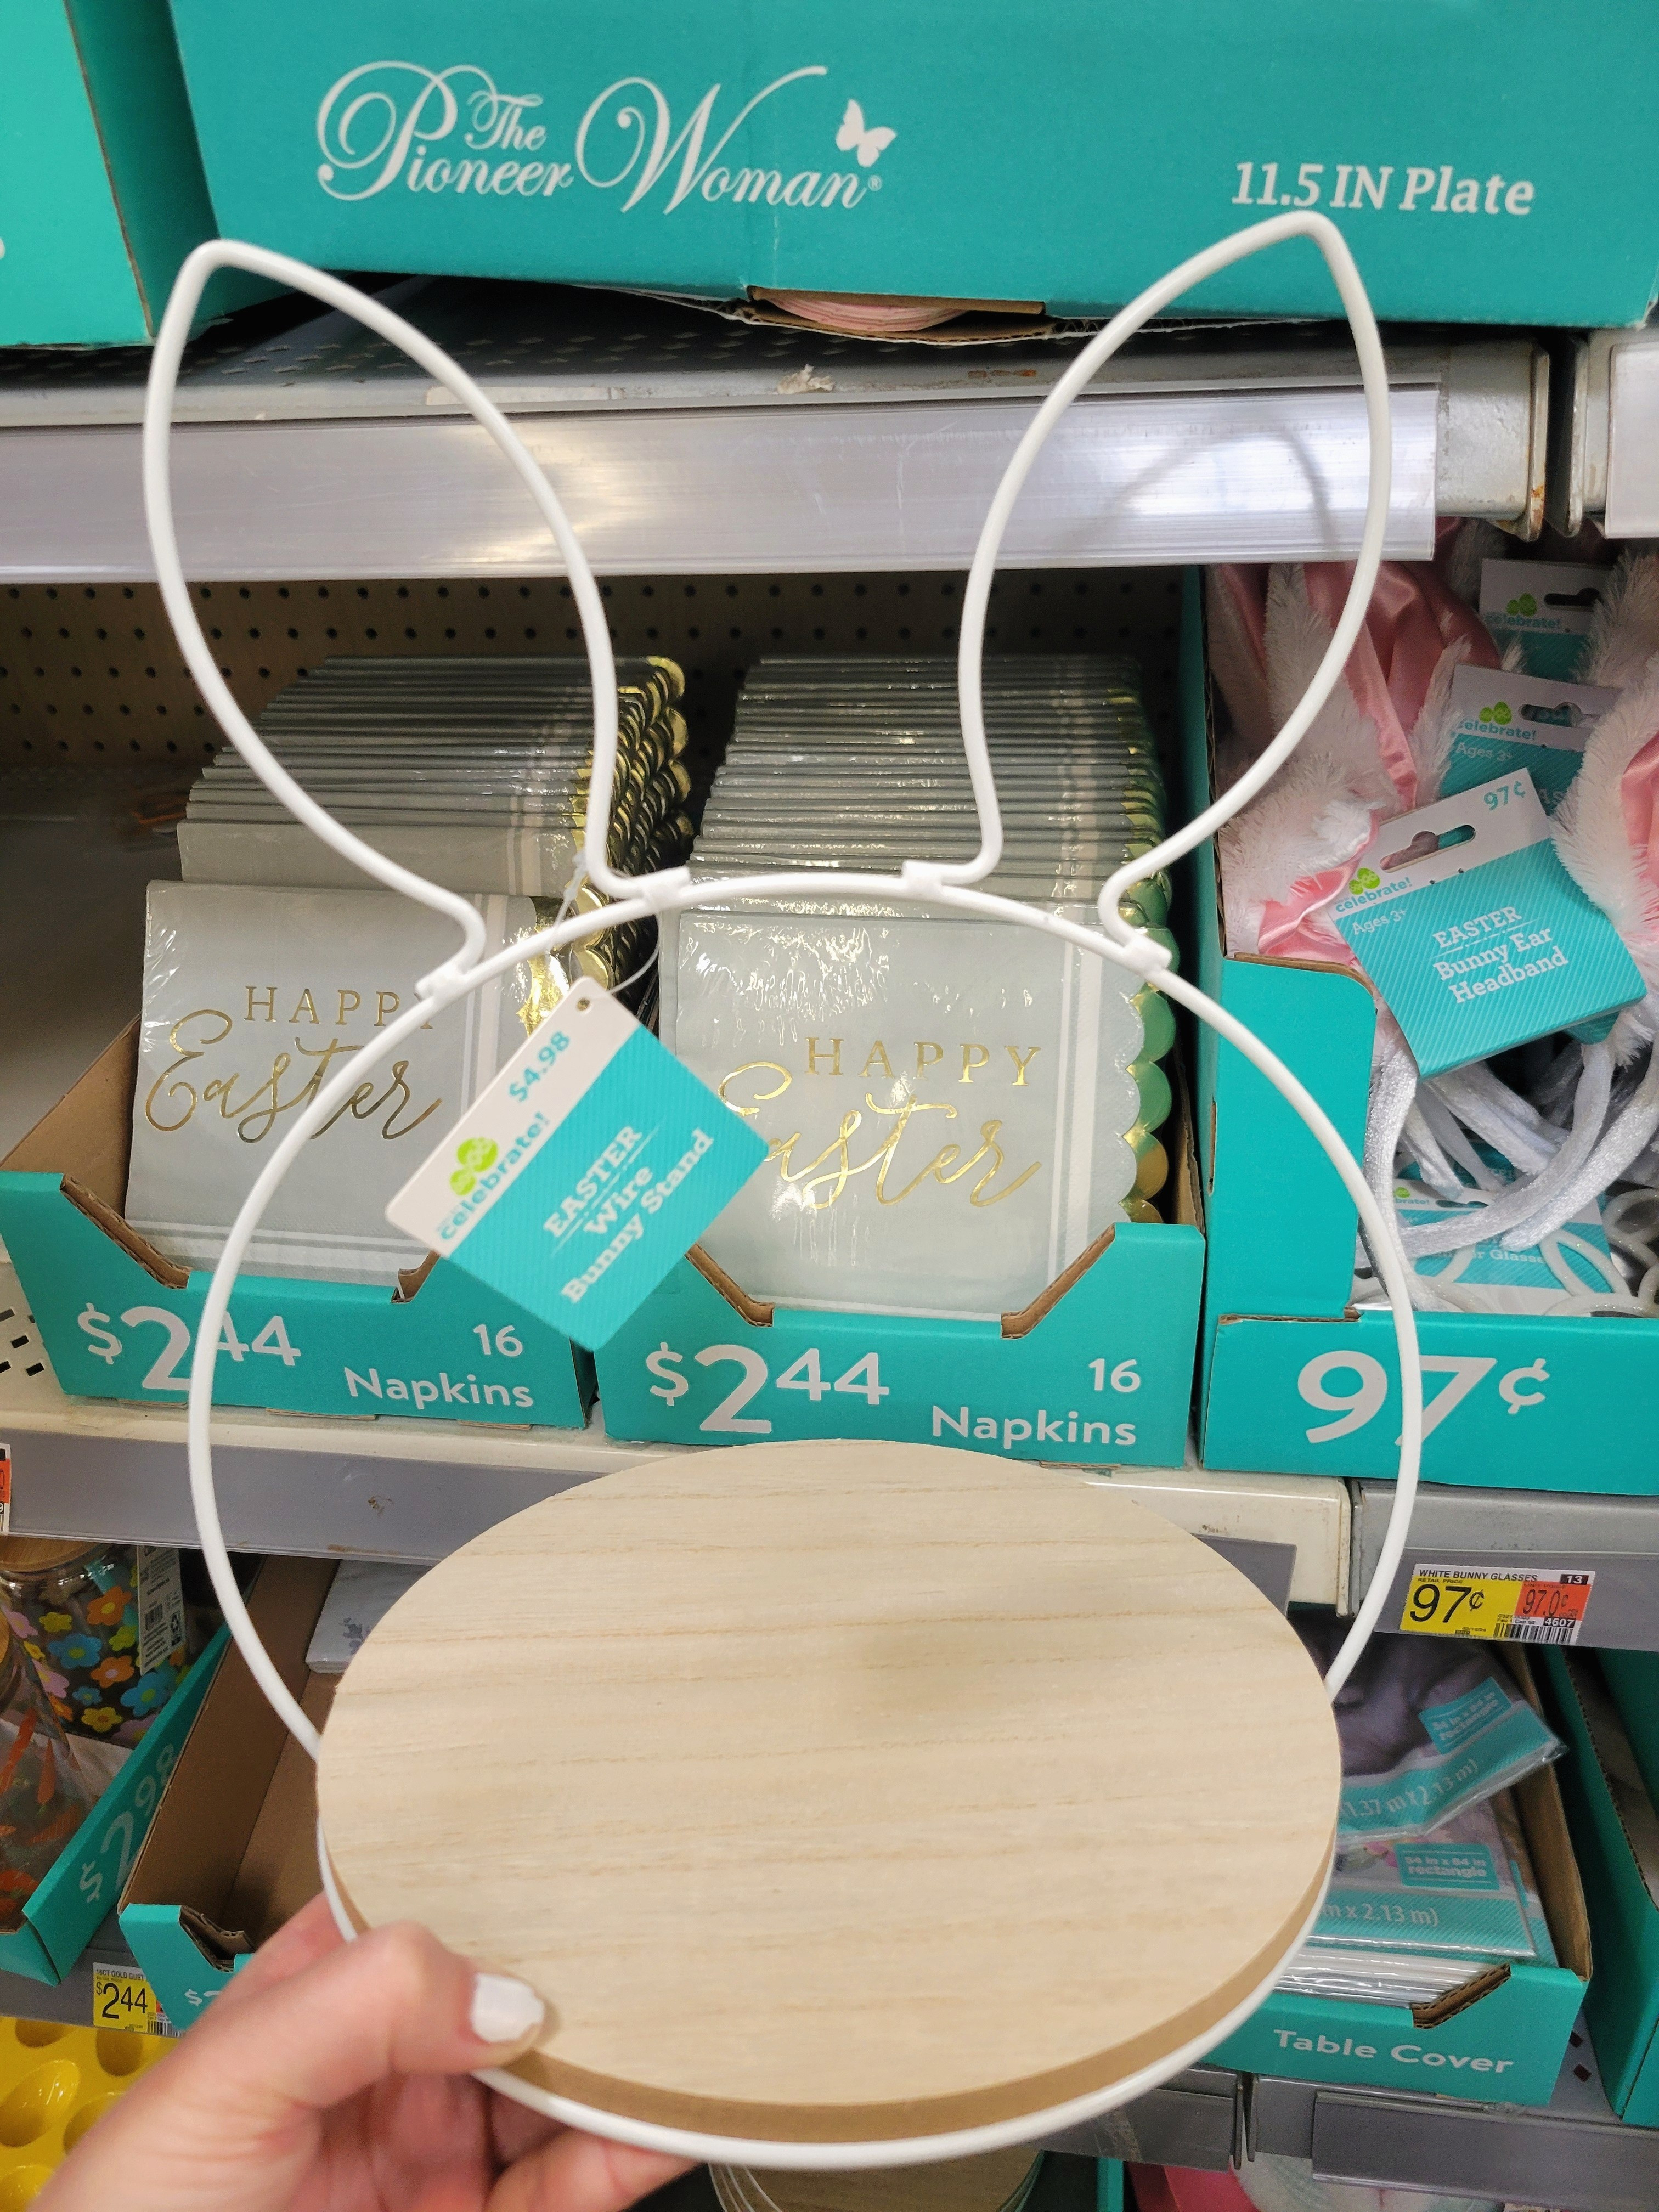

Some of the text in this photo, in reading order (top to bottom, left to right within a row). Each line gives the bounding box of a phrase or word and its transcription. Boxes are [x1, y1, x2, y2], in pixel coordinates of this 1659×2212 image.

[317, 60, 574, 201] Pioneer
[464, 69, 548, 151] The
[1232, 162, 1535, 216] 11.5 IN Plate
[1455, 742, 1493, 759] Ages
[1457, 718, 1536, 741] elebrate!
[1483, 781, 1526, 811] 97¢
[1335, 876, 1413, 913] celebrate!
[1352, 908, 1406, 935] Ages 3+
[1432, 906, 1522, 950] EASTER
[1432, 926, 1553, 980] Bunny Ear
[1448, 946, 1569, 1004] Headband
[244, 986, 433, 1030] HAPP
[508, 1030, 571, 1103] $4.98
[804, 1036, 1042, 1086] HAPPY
[440, 1110, 550, 1240] celebrate!
[544, 1125, 643, 1238] EASTER
[561, 1127, 714, 1305] Bunny Stand
[583, 1165, 654, 1235] Wire
[1489, 1249, 1546, 1264] Glasse
[473, 1323, 523, 1358] 16
[343, 1367, 534, 1409] Napkins
[1088, 1358, 1141, 1392] 16
[932, 1405, 1137, 1450] Napkins
[1419, 1568, 1584, 1585] WHITE BUNNY GLASSES 13
[1545, 1617, 1575, 1628] 4607
[1362, 1903, 1406, 1922] 2.13
[97, 1968, 110, 1977] 16CT
[111, 1970, 127, 1979] GOLD
[1273, 2028, 1514, 2074] Table Cover
